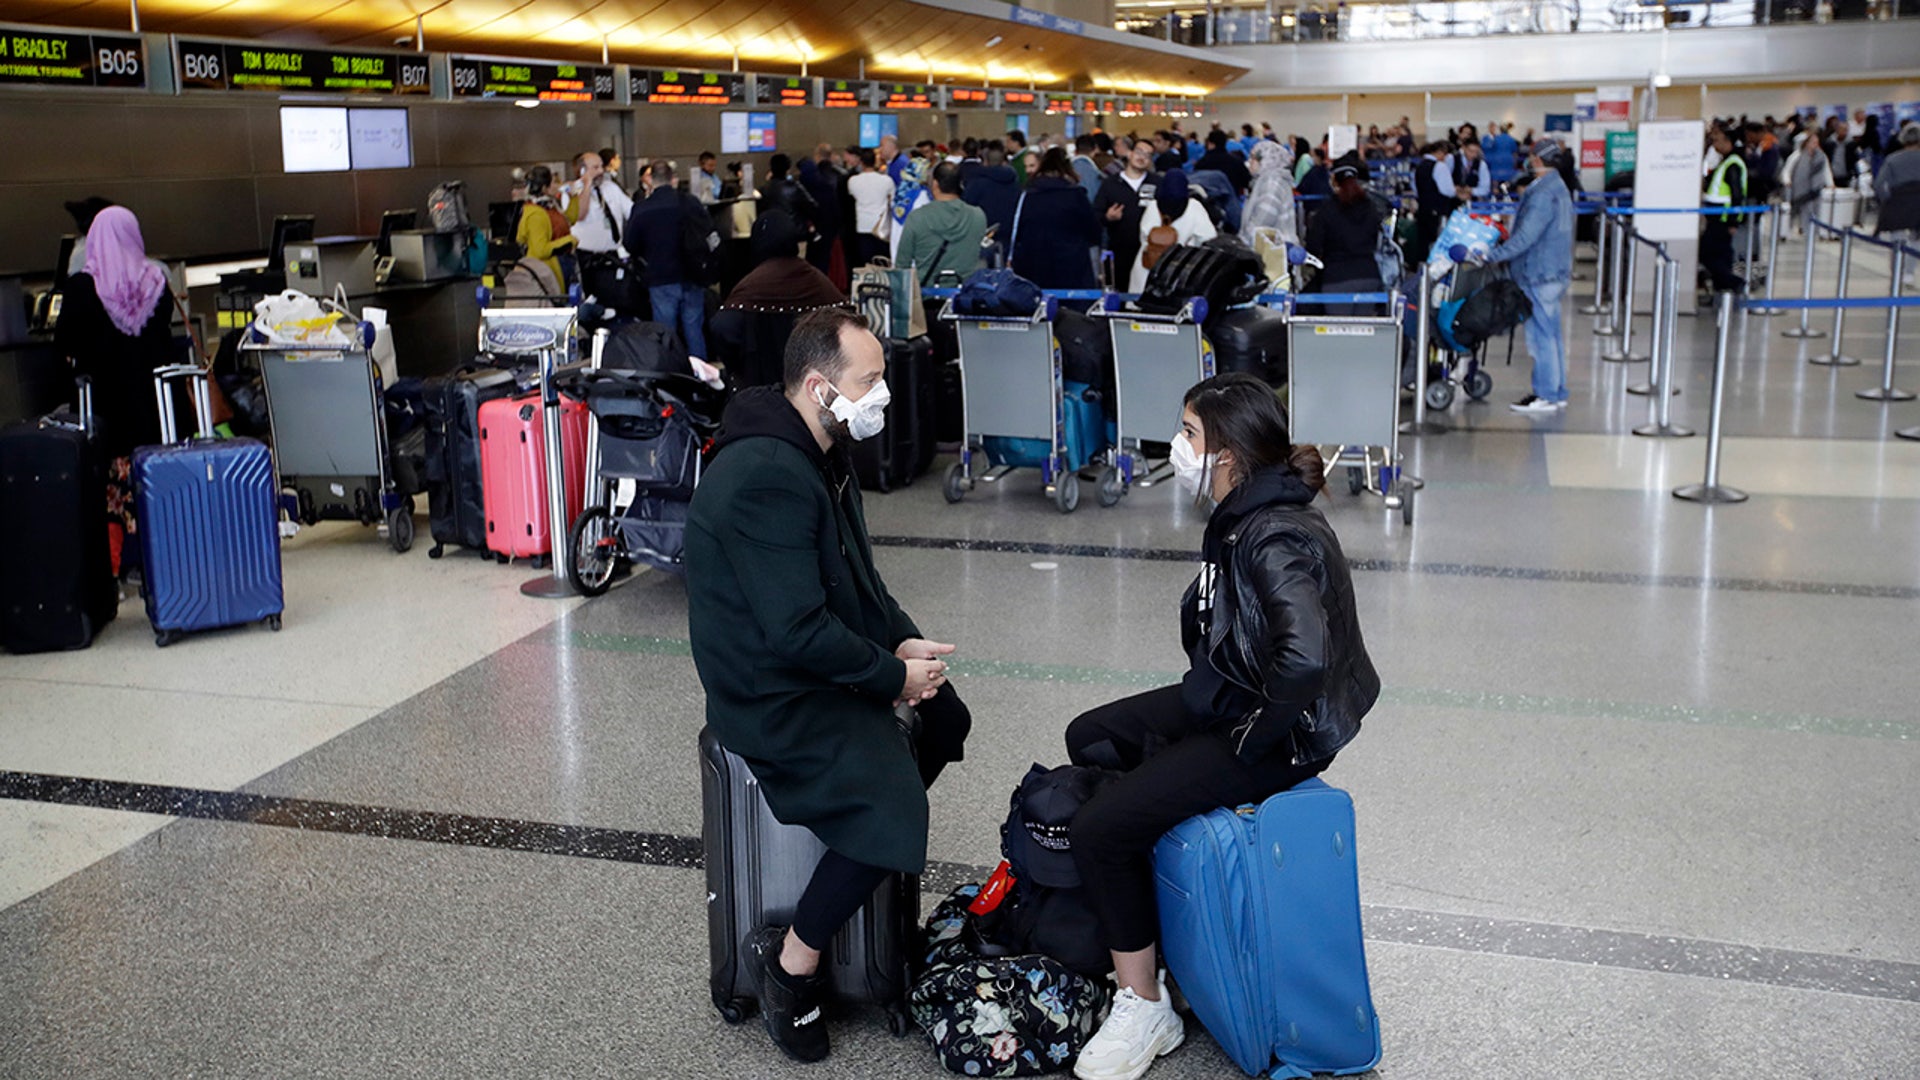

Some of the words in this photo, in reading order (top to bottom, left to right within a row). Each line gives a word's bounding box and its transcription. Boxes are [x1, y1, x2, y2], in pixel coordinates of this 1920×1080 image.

[12, 37, 68, 60] BRADLEY
[99, 48, 138, 75] B05
[184, 53, 220, 79] B06
[241, 50, 262, 70] TOM
[264, 52, 302, 72] BRADLEY
[402, 64, 427, 86] B07
